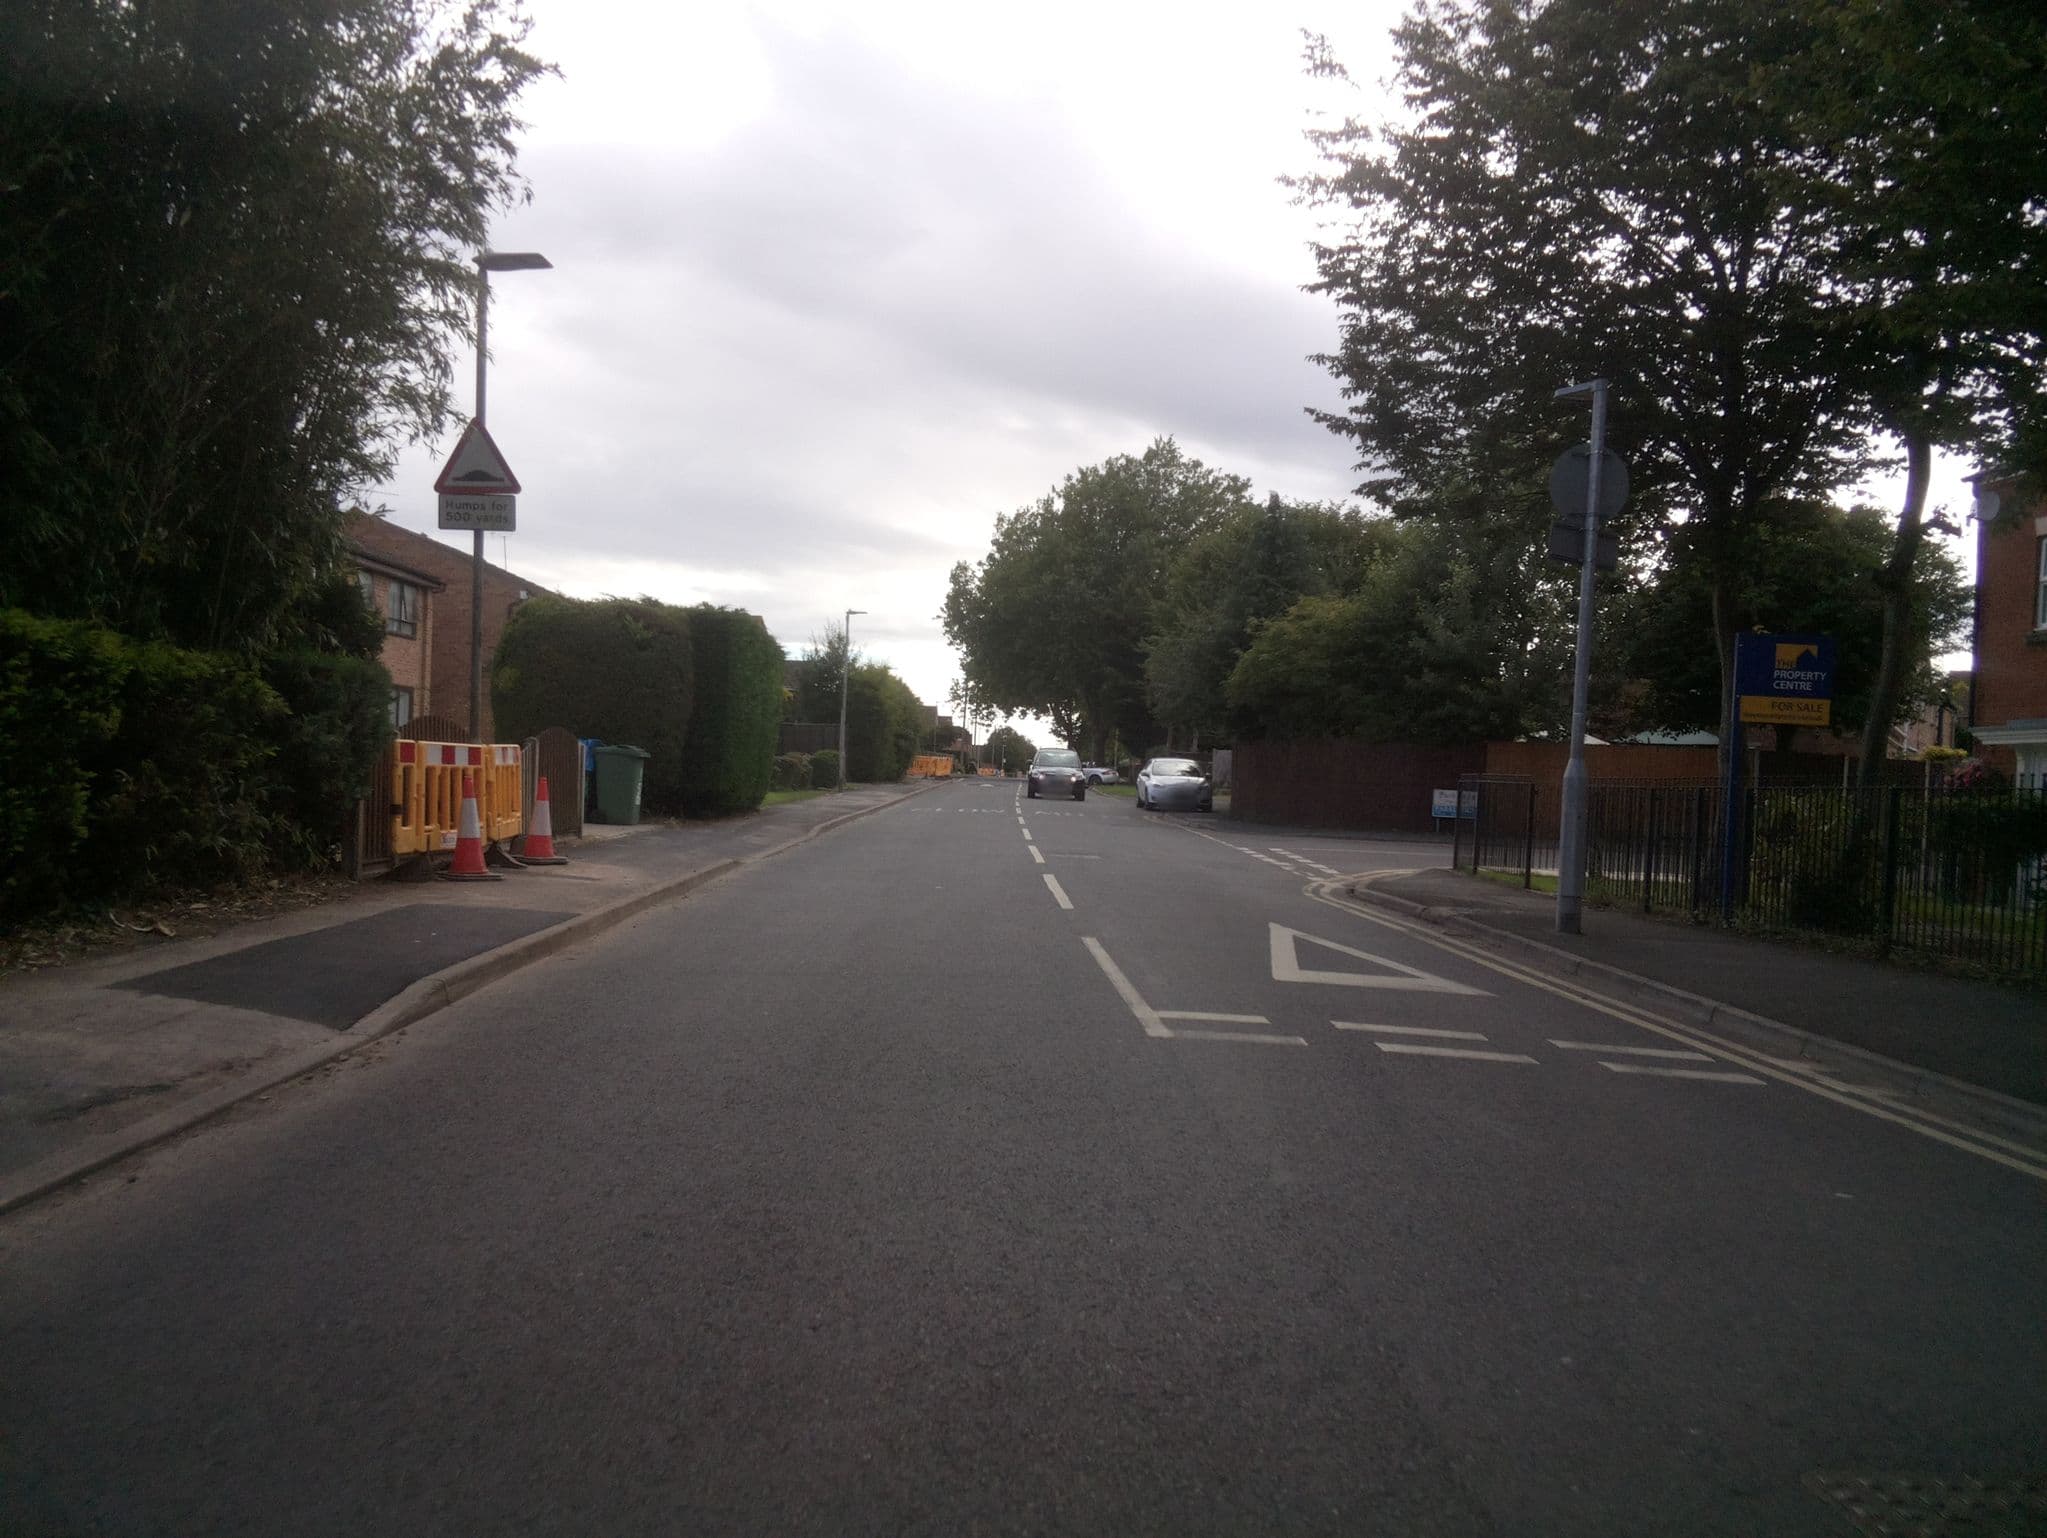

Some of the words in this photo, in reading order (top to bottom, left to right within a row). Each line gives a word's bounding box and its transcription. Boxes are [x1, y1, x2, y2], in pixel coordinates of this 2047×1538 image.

[446, 500, 486, 511] Humps
[492, 500, 508, 511] for
[446, 511, 471, 522] 500
[476, 513, 508, 524] yards
[1774, 670, 1826, 680] PROPERTY
[1773, 681, 1813, 690] CENTRE
[1771, 702, 1793, 711] FOR
[1797, 703, 1824, 712] SALE
